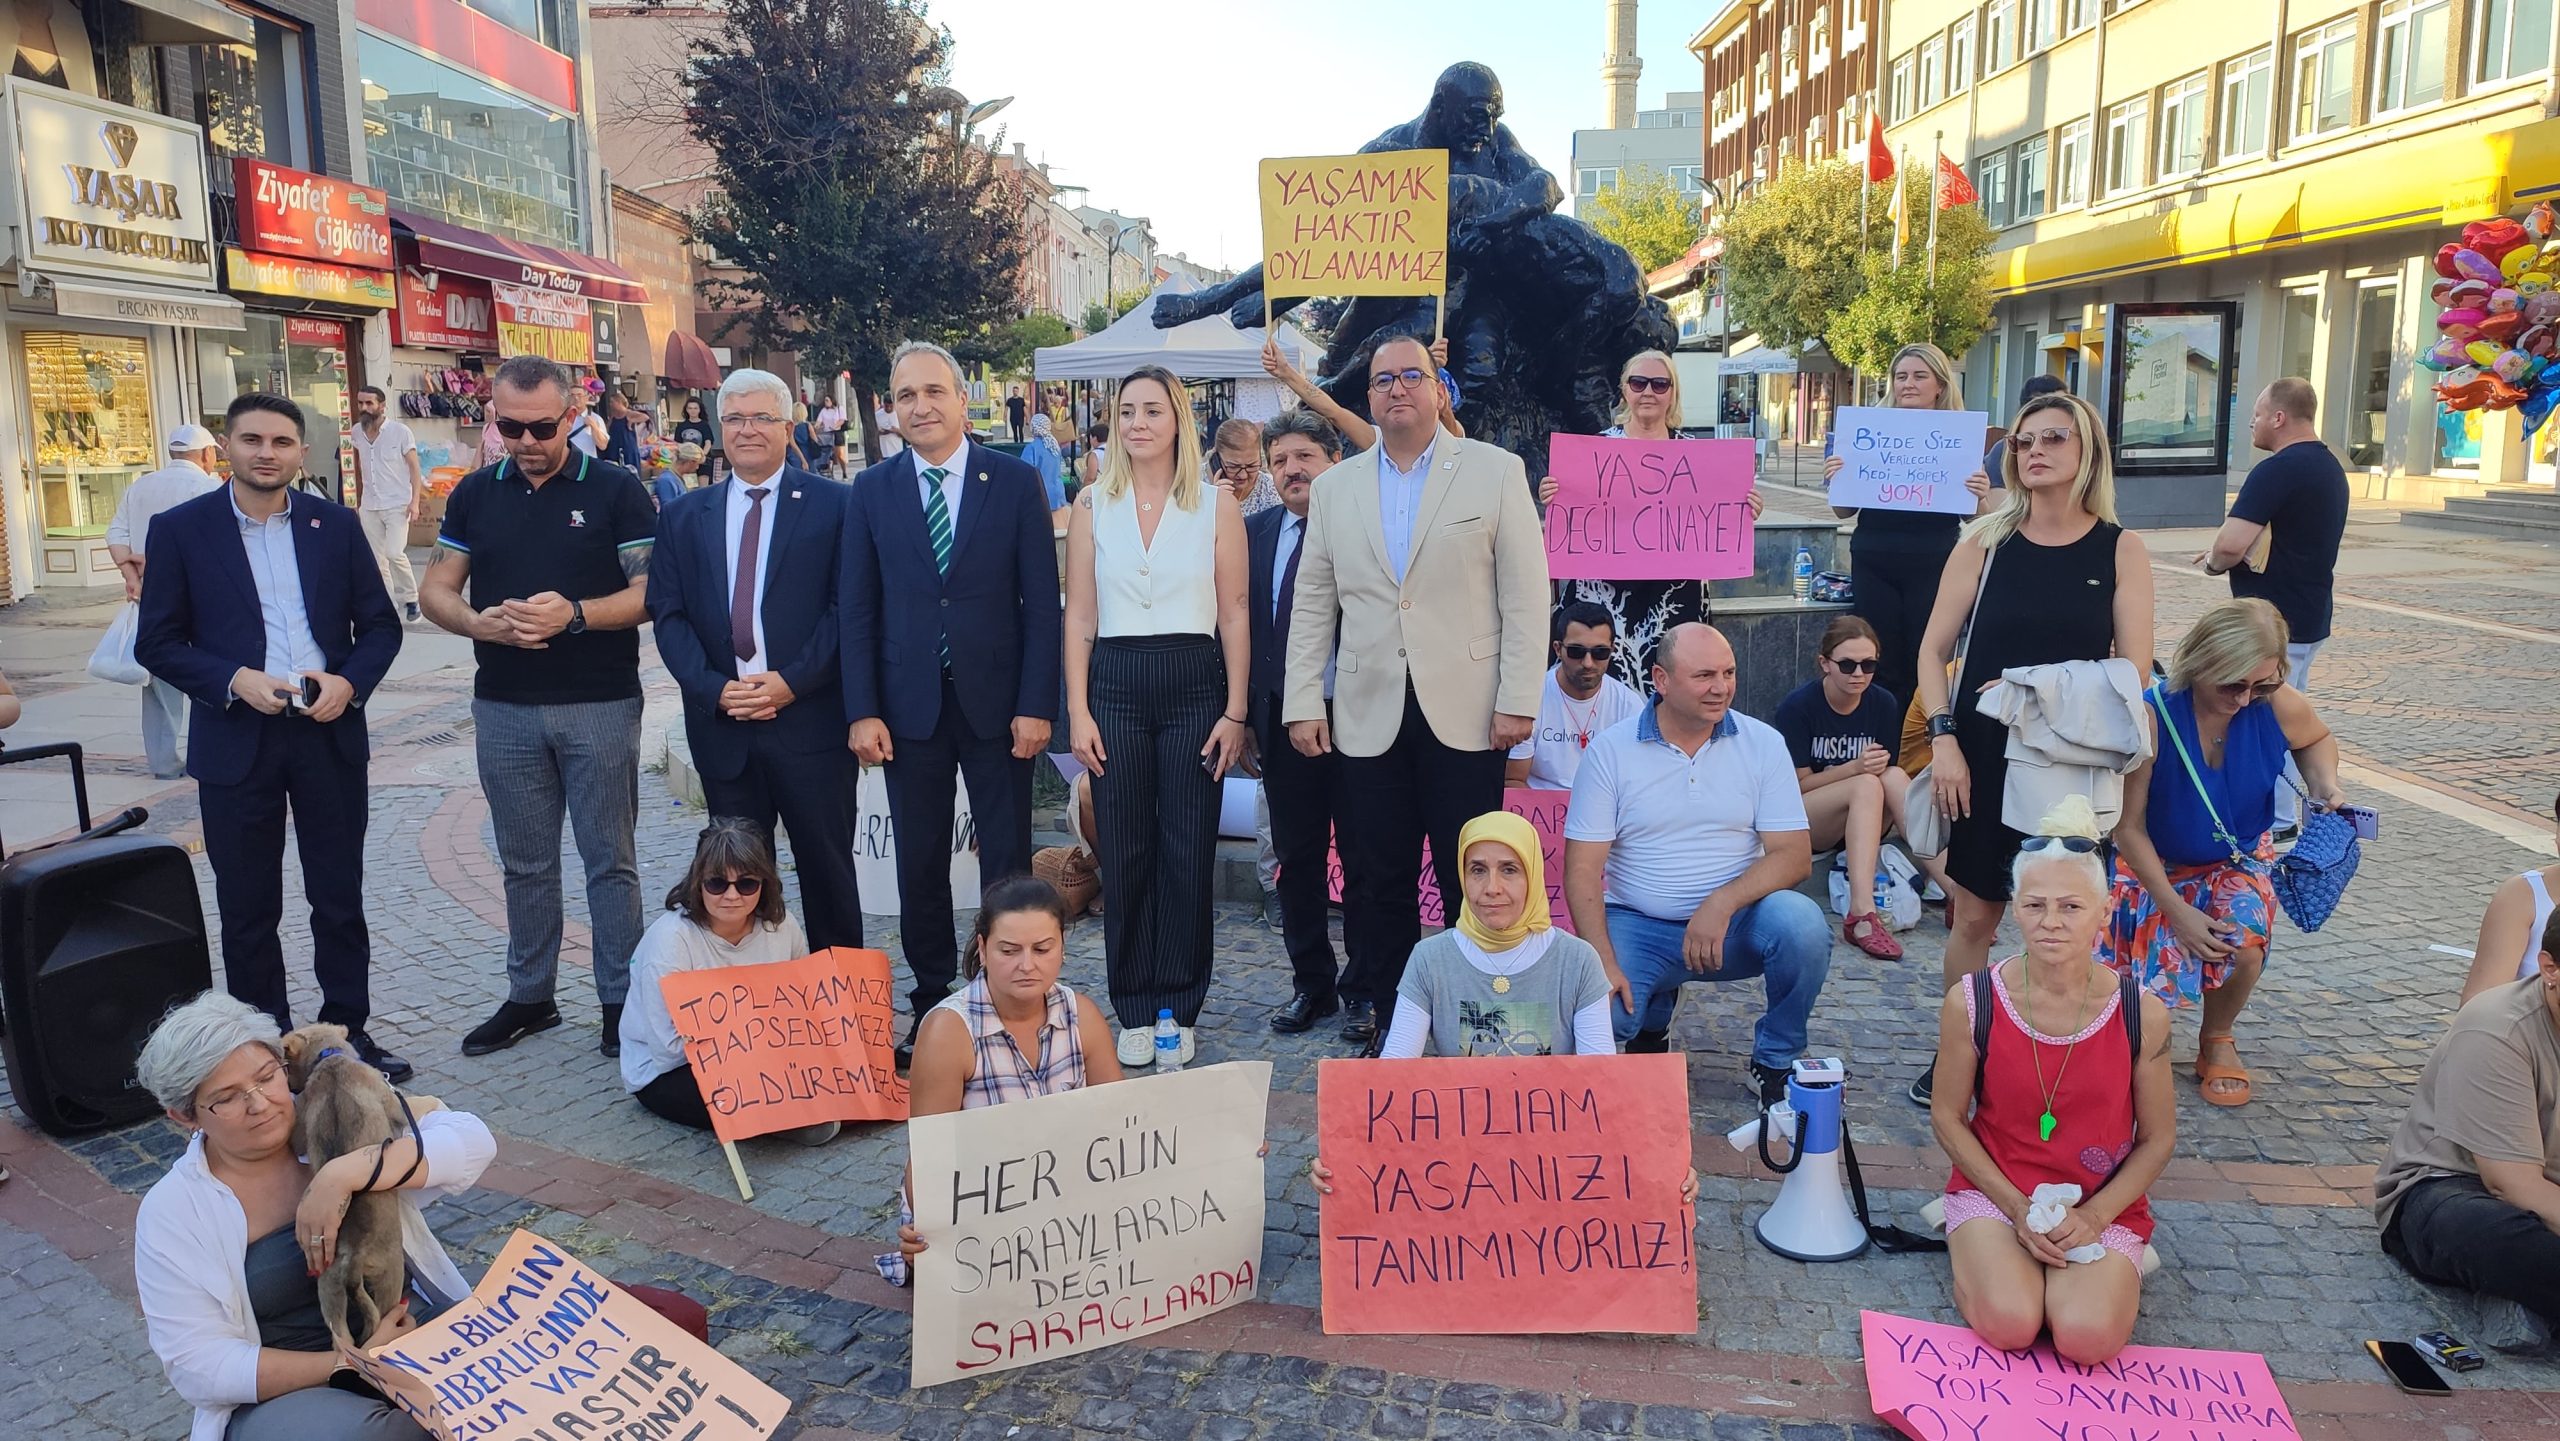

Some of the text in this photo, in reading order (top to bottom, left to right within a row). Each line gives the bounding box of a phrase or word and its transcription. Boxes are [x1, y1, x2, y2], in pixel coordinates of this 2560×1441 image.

[62, 163, 183, 223] YAŞAR
[256, 168, 331, 216] Ziyafet
[1274, 164, 1438, 208] YAŞAMAK
[315, 215, 388, 257] Çiğköfte
[1294, 209, 1416, 245] HAKTIR
[235, 256, 289, 289] Ziyafet
[521, 265, 583, 295] Day Today
[1269, 248, 1445, 282] OYLANAMAZ
[118, 300, 201, 324] ERCAN YAŞAR
[291, 319, 315, 335] Ziyafet
[446, 293, 492, 332] DAY
[529, 307, 575, 329] ALIRSAN
[1594, 451, 1698, 499] YASA
[1878, 483, 1934, 507] YOK!
[1906, 467, 1950, 486] KÖPEK
[1632, 500, 1750, 554] CİNAYET
[1542, 727, 1580, 743] Calvin
[1366, 1071, 1603, 1143] KATLİAM
[952, 1115, 1178, 1226] HER GÜN
[1356, 1153, 1632, 1214] YASANIZI
[950, 1188, 1227, 1294] SARAYLARDA
[1335, 1208, 1691, 1291] TANIMIYORUZ!
[427, 1344, 468, 1367] ve
[448, 1243, 565, 1349] BİLİMİN
[1031, 1254, 1155, 1309] DEĞİL
[955, 1259, 1254, 1370] SARAÇLARDA
[1881, 1326, 2044, 1374] YAŞAM
[1914, 1368, 2012, 1407] YOK
[2033, 1377, 2296, 1434] SAYANLARA
